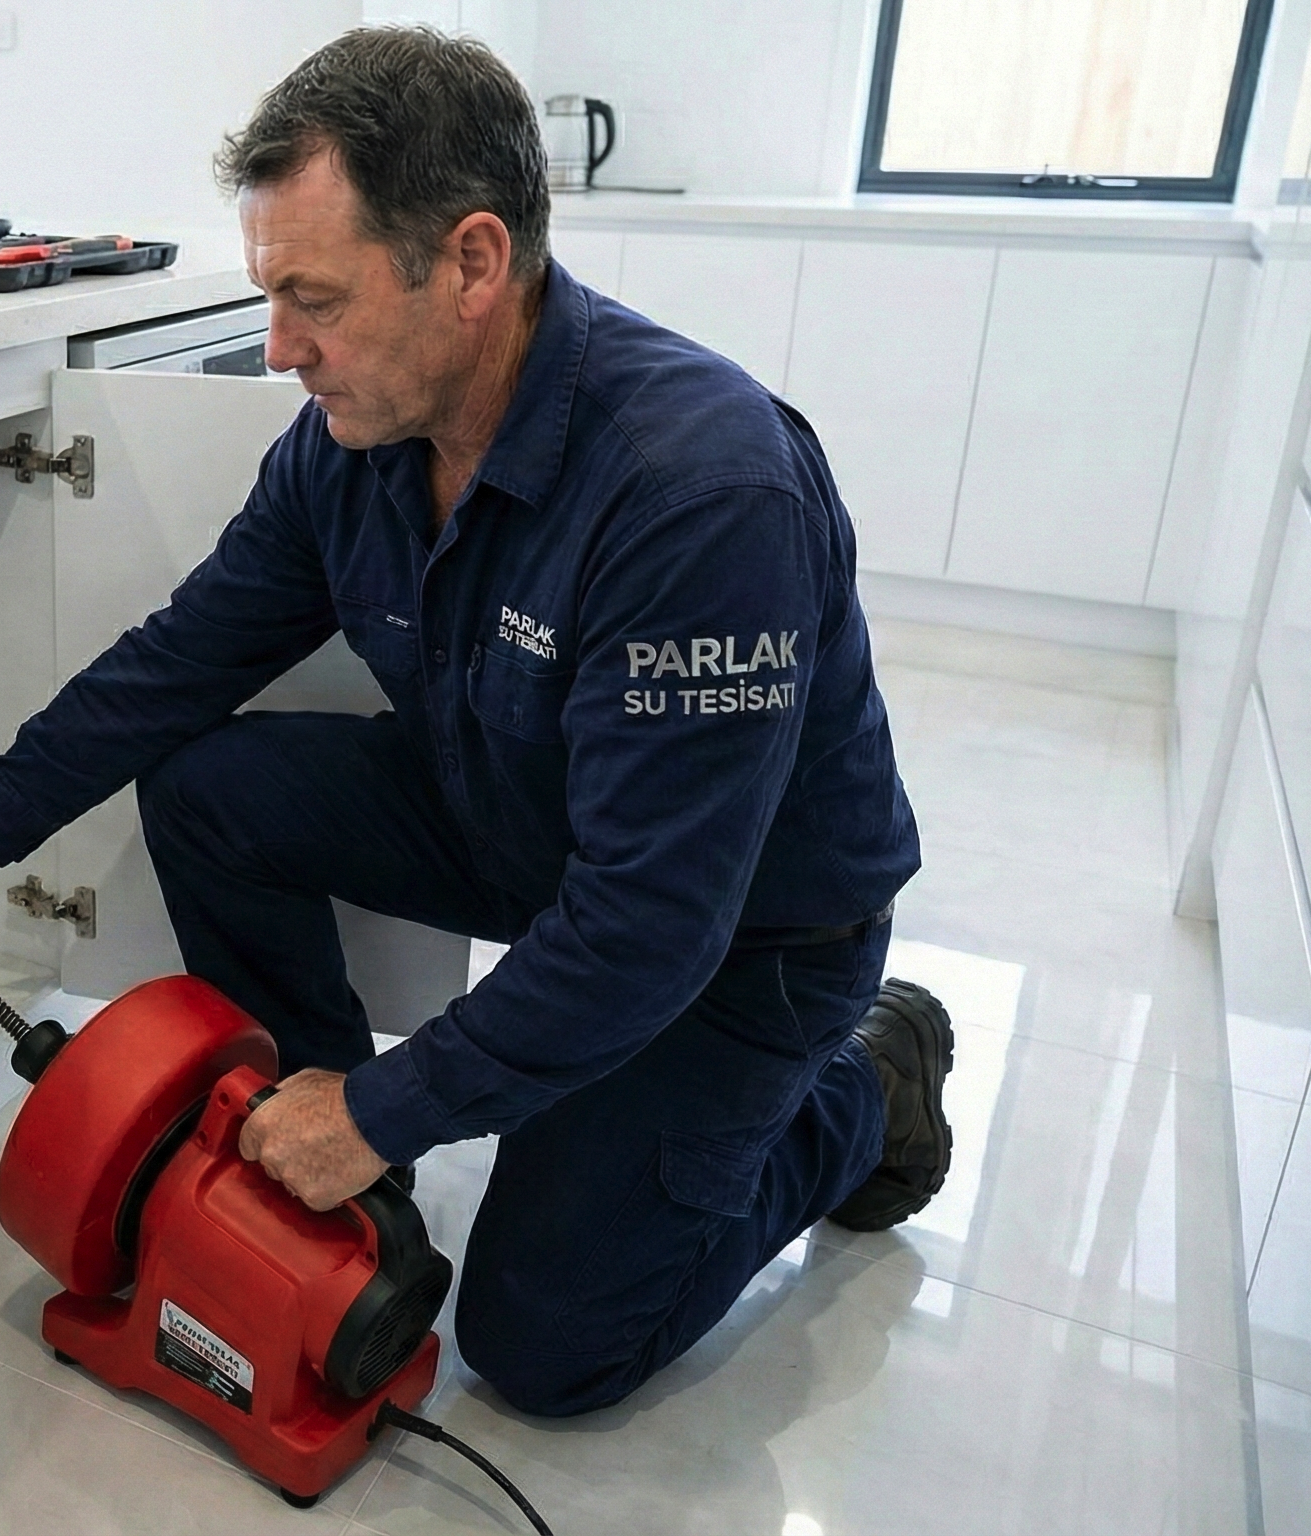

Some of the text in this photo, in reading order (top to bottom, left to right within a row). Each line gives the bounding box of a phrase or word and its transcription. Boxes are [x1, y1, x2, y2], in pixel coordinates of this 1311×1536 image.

[500, 605, 556, 646] PARLAK
[626, 630, 799, 679] PARLAK
[624, 679, 795, 715] SU TESİSATI
